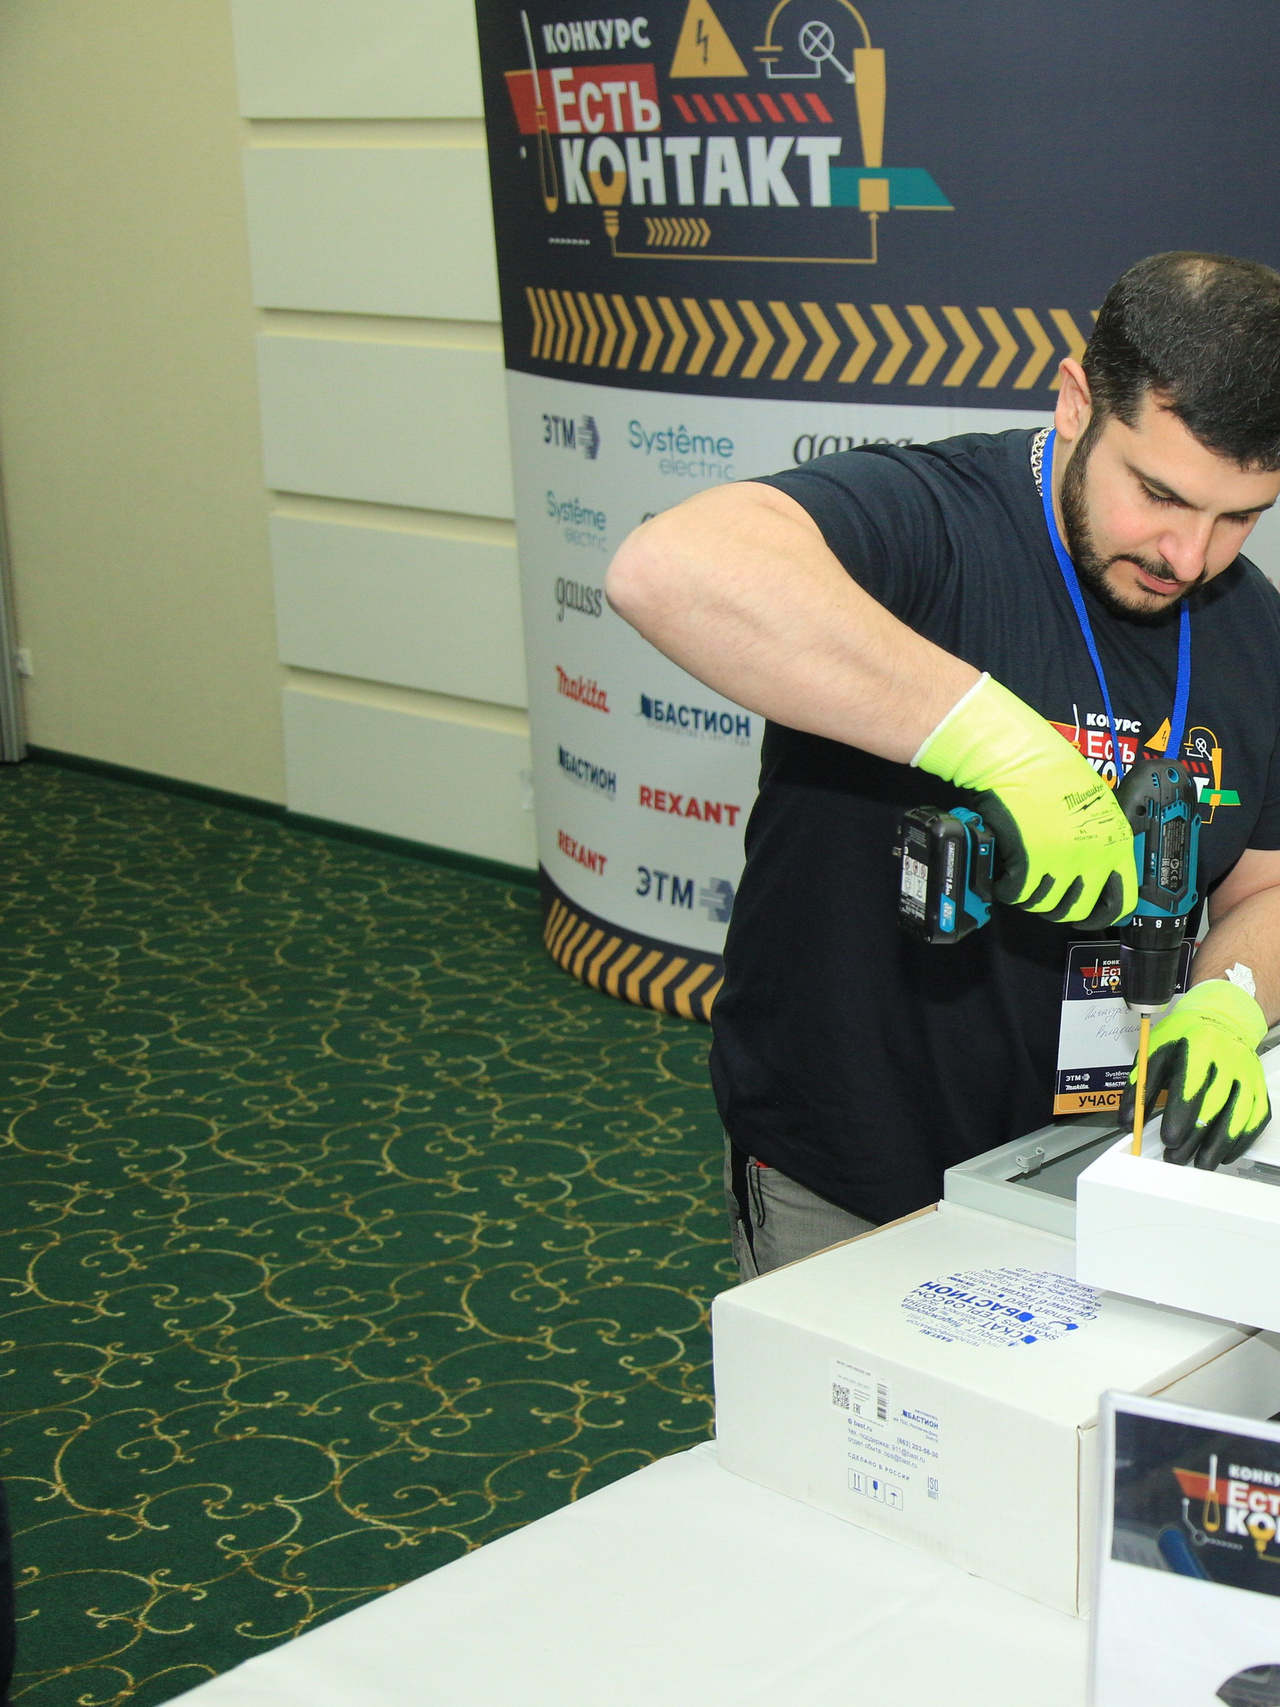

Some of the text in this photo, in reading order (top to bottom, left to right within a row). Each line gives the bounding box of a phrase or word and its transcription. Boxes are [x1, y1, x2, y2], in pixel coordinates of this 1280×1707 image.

[543, 17, 650, 54] КОНКУРС
[560, 136, 842, 207] КОНТАКТ
[542, 413, 576, 451] ЭТМ
[628, 419, 735, 457] Systême
[659, 454, 736, 481] electric
[546, 491, 607, 532] Systême
[555, 576, 604, 622] gauss
[653, 699, 751, 737] БАСТИОН
[565, 749, 617, 794] БАСТИОН
[639, 785, 741, 827] REXANT
[558, 830, 608, 876] REXANT
[636, 866, 694, 910] ЭТМ
[1155, 919, 1163, 929] 8
[917, 1280, 1021, 1317] БАСТИОН
[976, 1320, 1026, 1339] СКАТ
[907, 1411, 938, 1429] БАСТИОН
[847, 1451, 876, 1468] СДЕЛАНО
[885, 1465, 910, 1481] РОССИИ
[927, 1475, 938, 1492] ISO
